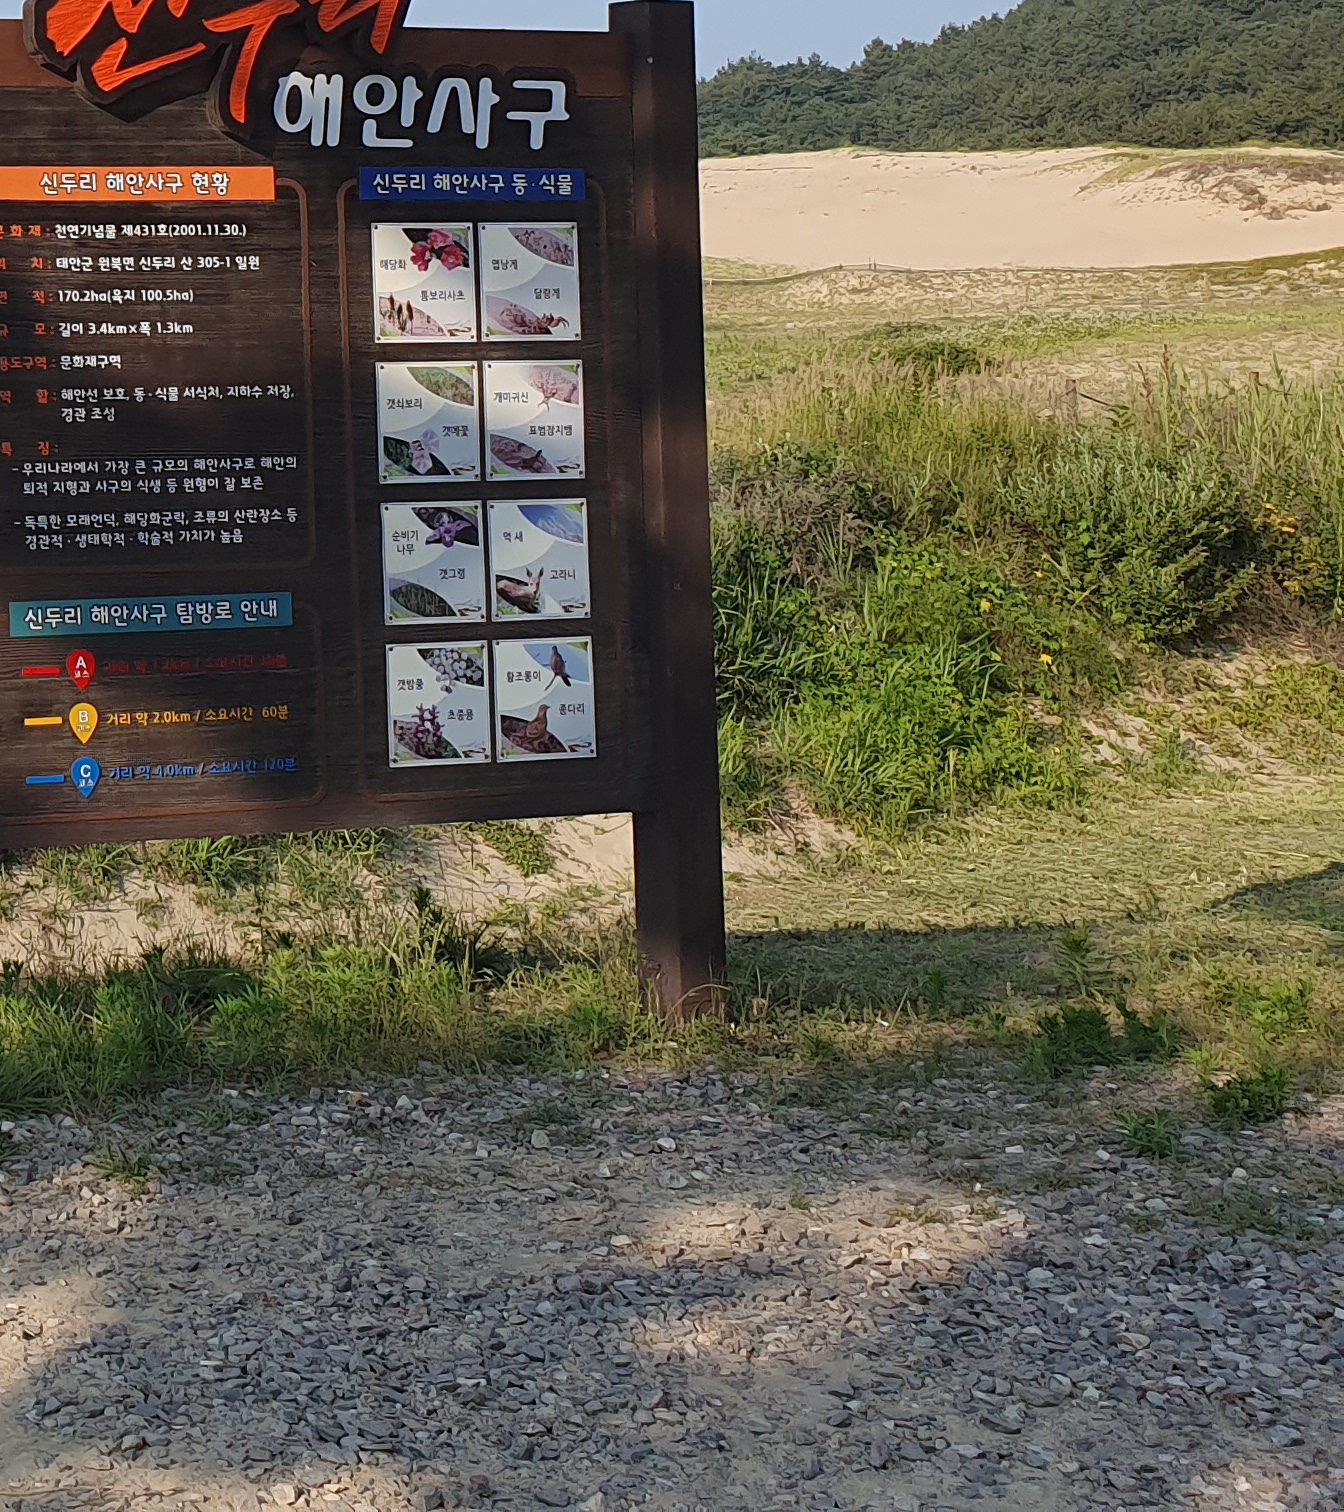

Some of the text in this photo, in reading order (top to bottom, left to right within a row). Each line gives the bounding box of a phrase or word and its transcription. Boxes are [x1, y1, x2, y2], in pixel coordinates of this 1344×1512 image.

[274, 70, 569, 150] 해안사구
[40, 172, 230, 196] 신두리 해안사구 현황
[373, 174, 425, 194] 신두리
[433, 173, 504, 194] 해안사구
[54, 224, 117, 240] 천연기념물
[56, 256, 260, 271] 태안군 원북면 신두리 산 305-1 일원
[380, 259, 407, 270] 해당화
[492, 259, 518, 270] 엽낭게
[141, 290, 194, 303] 100.5ha)
[58, 322, 84, 337] 길이
[156, 322, 193, 334] 1.3km
[60, 354, 122, 370] 문화재구역
[61, 388, 98, 402] 해안선
[183, 386, 223, 400] 서식처,
[227, 385, 262, 399] 지하수
[267, 384, 294, 399] 저장,
[494, 392, 529, 403] 개미귀신
[386, 398, 422, 410] 갯쇠보리
[61, 407, 115, 423] 경관 조성
[528, 425, 573, 436] 표범장지뱀
[22, 456, 297, 476] 우리나라에서 가장 큰 규모의 해안사구로 해안의
[23, 476, 265, 496] 퇴적 지형과 사구의 식생 등 원형이 잘 보존
[24, 508, 298, 531] 독특한 모래언덕, 해당화군락, 조류의 산란장소 등
[179, 530, 215, 543] 가치가
[392, 530, 418, 542] 순비기
[396, 543, 415, 555] 나무
[550, 569, 576, 580] 고라니
[25, 599, 278, 630] 신두리 해안사구 탐방로 안내
[76, 656, 86, 668] A
[78, 710, 88, 723] B
[107, 705, 290, 726] 거리 약 2.0km 소요시간 60분
[80, 764, 91, 778] C
[109, 767, 133, 780] 거리
[139, 766, 151, 780] 약
[208, 760, 256, 775] 소요시간
